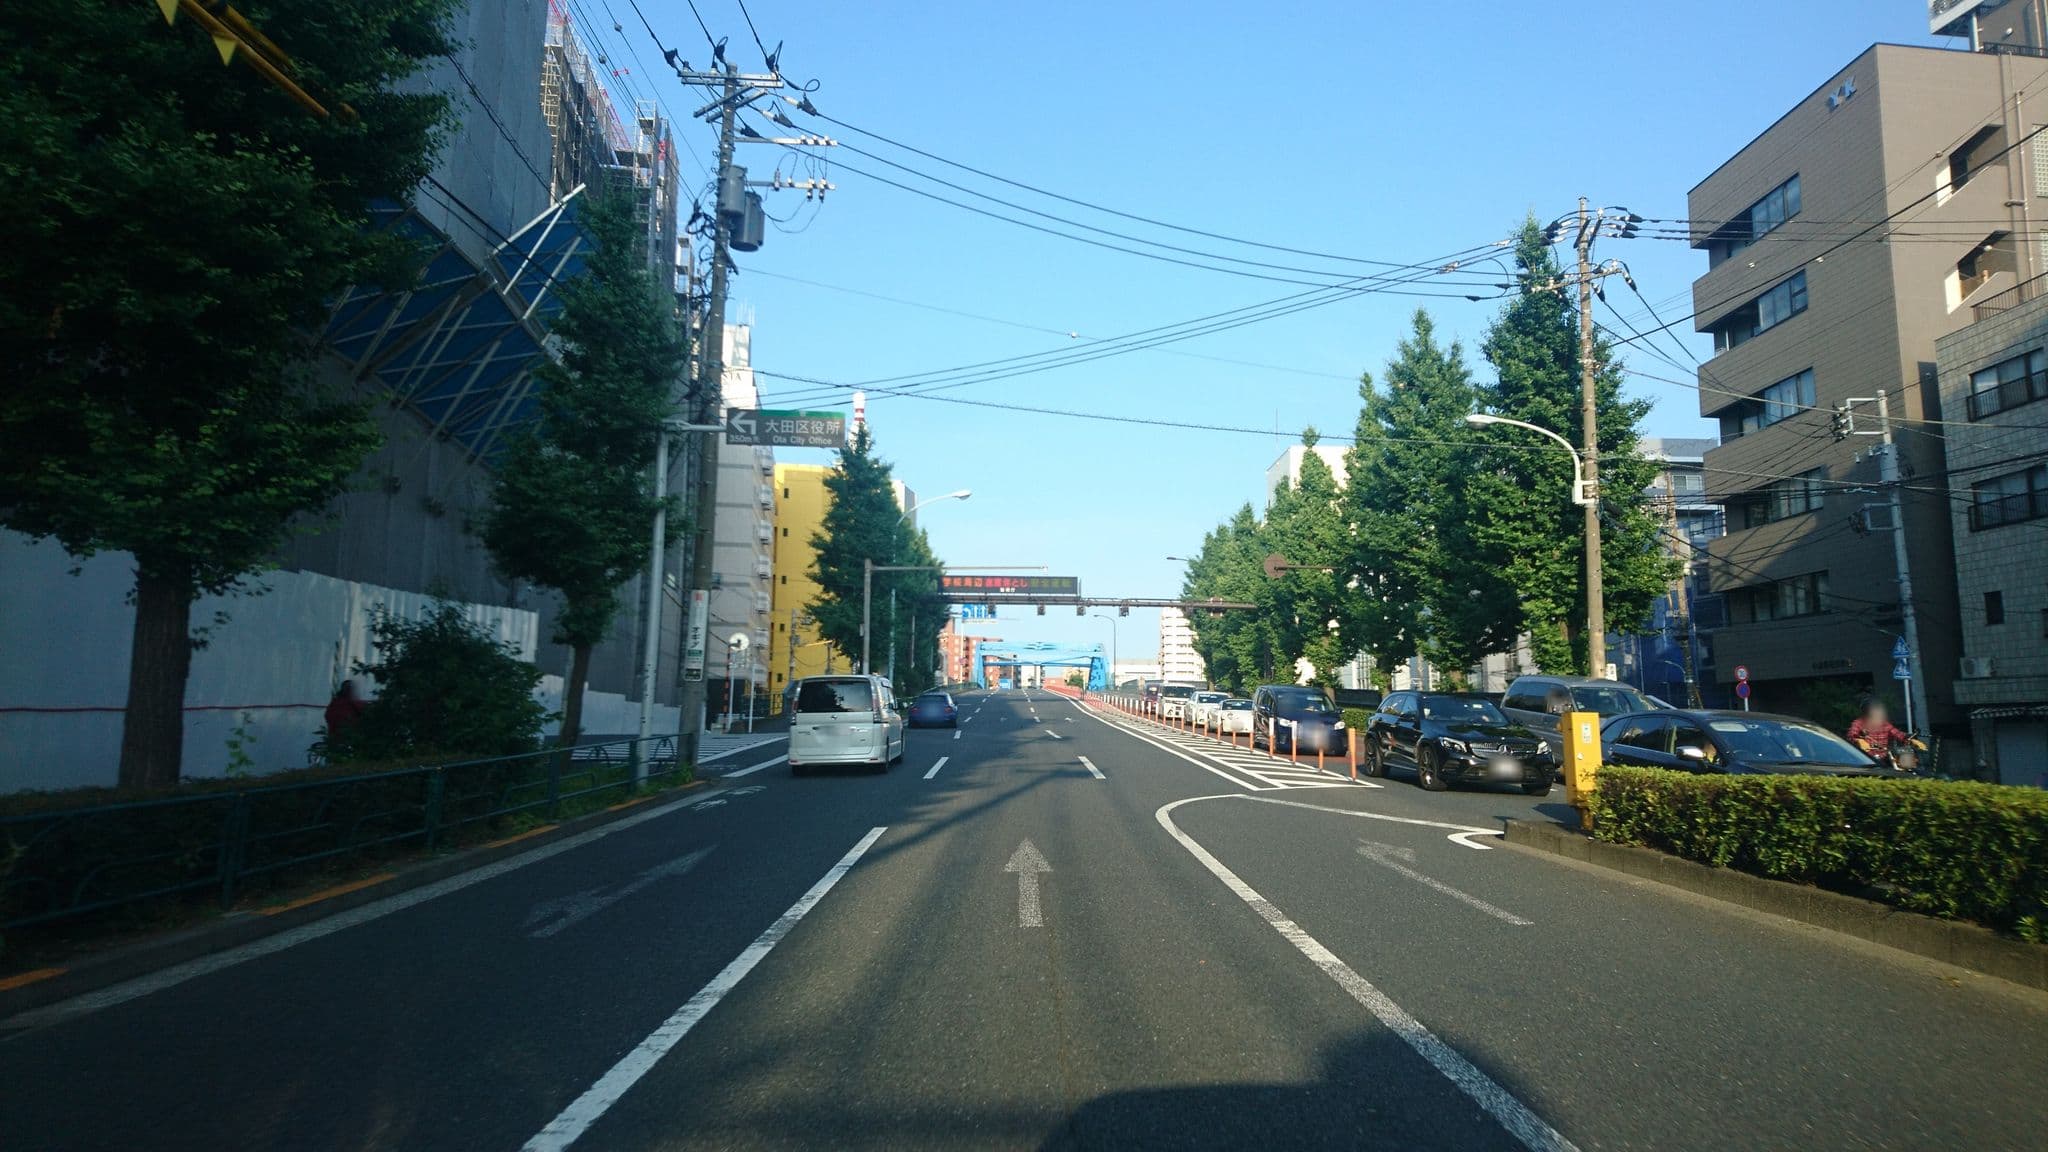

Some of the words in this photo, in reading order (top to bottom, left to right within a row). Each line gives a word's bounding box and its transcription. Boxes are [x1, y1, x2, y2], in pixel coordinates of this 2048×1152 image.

[1828, 76, 1857, 108] YK
[765, 419, 840, 435] 大田区役所
[773, 435, 787, 444] Ota
[790, 436, 805, 446] City
[808, 436, 833, 445] Office
